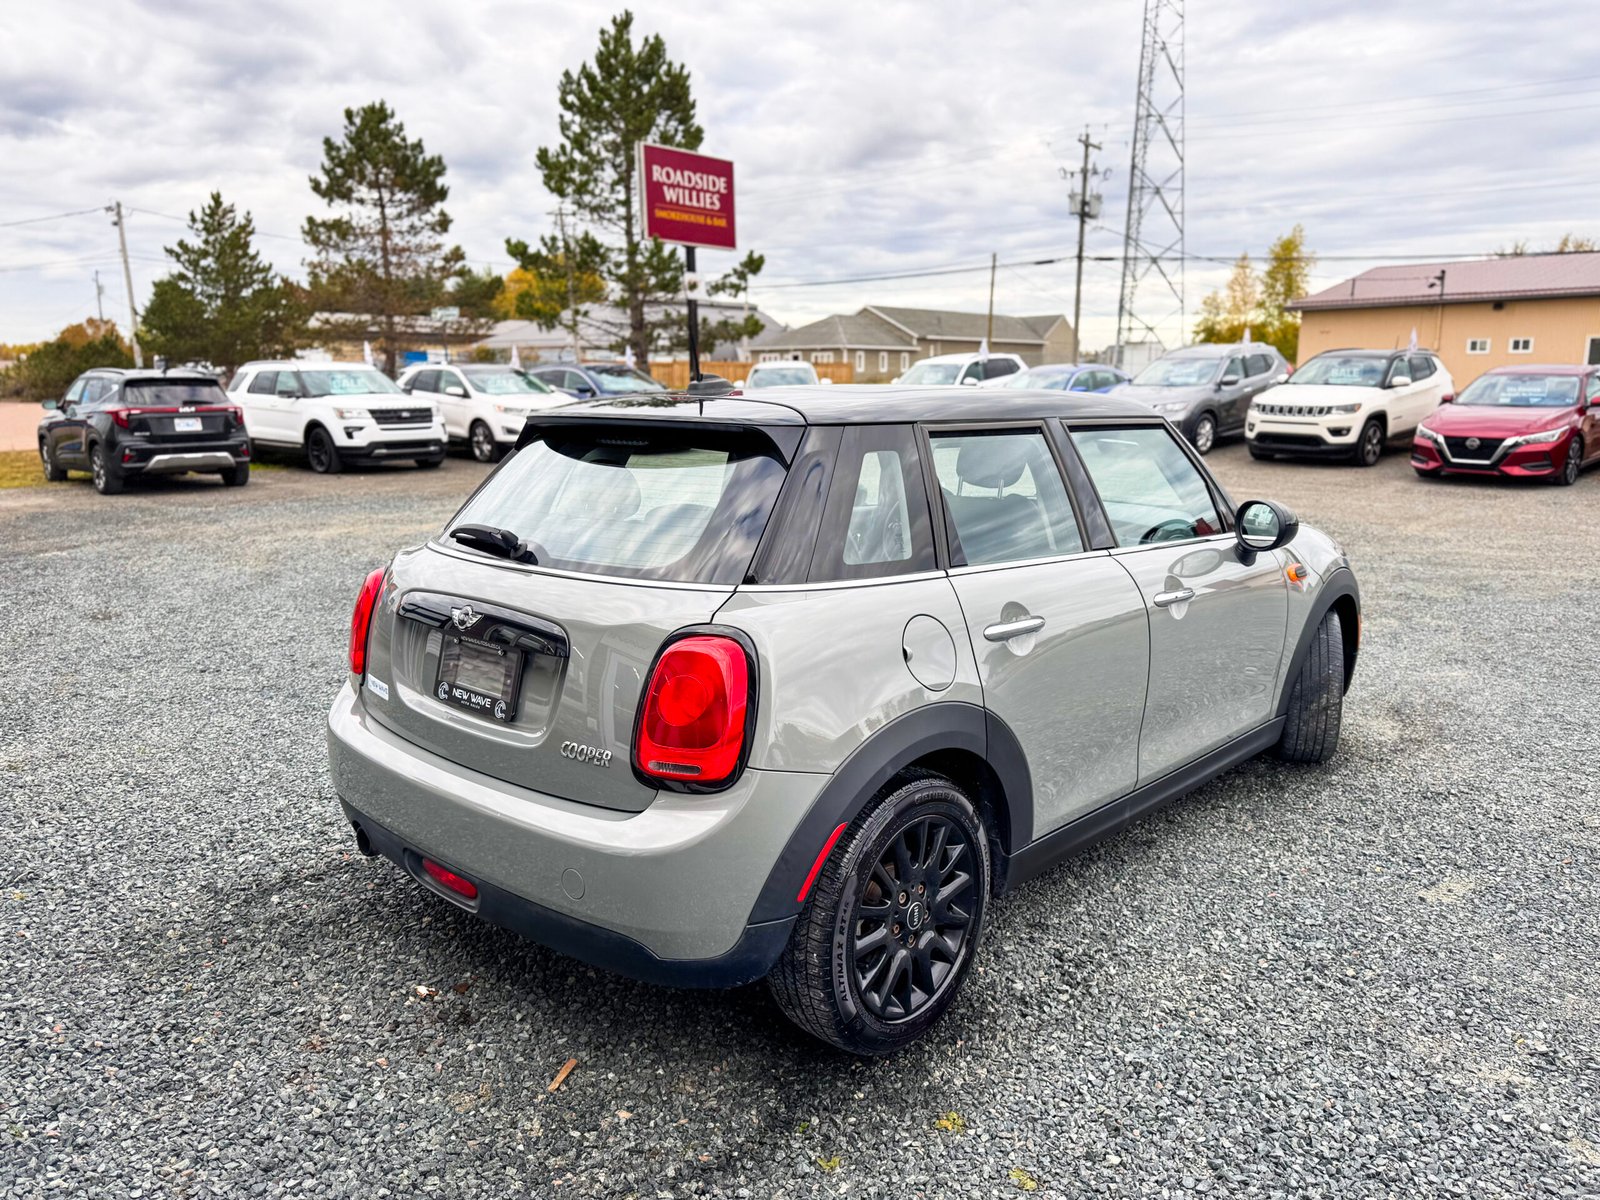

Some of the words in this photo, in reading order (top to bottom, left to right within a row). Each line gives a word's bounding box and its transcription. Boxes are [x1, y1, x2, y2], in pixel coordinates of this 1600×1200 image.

[651, 164, 728, 195] ROADSIDE
[662, 185, 721, 211] WILLIES
[452, 687, 470, 700] NEW
[470, 692, 492, 708] WAVE
[560, 740, 613, 768] COOPER
[837, 942, 848, 1001] ALTIMAX
